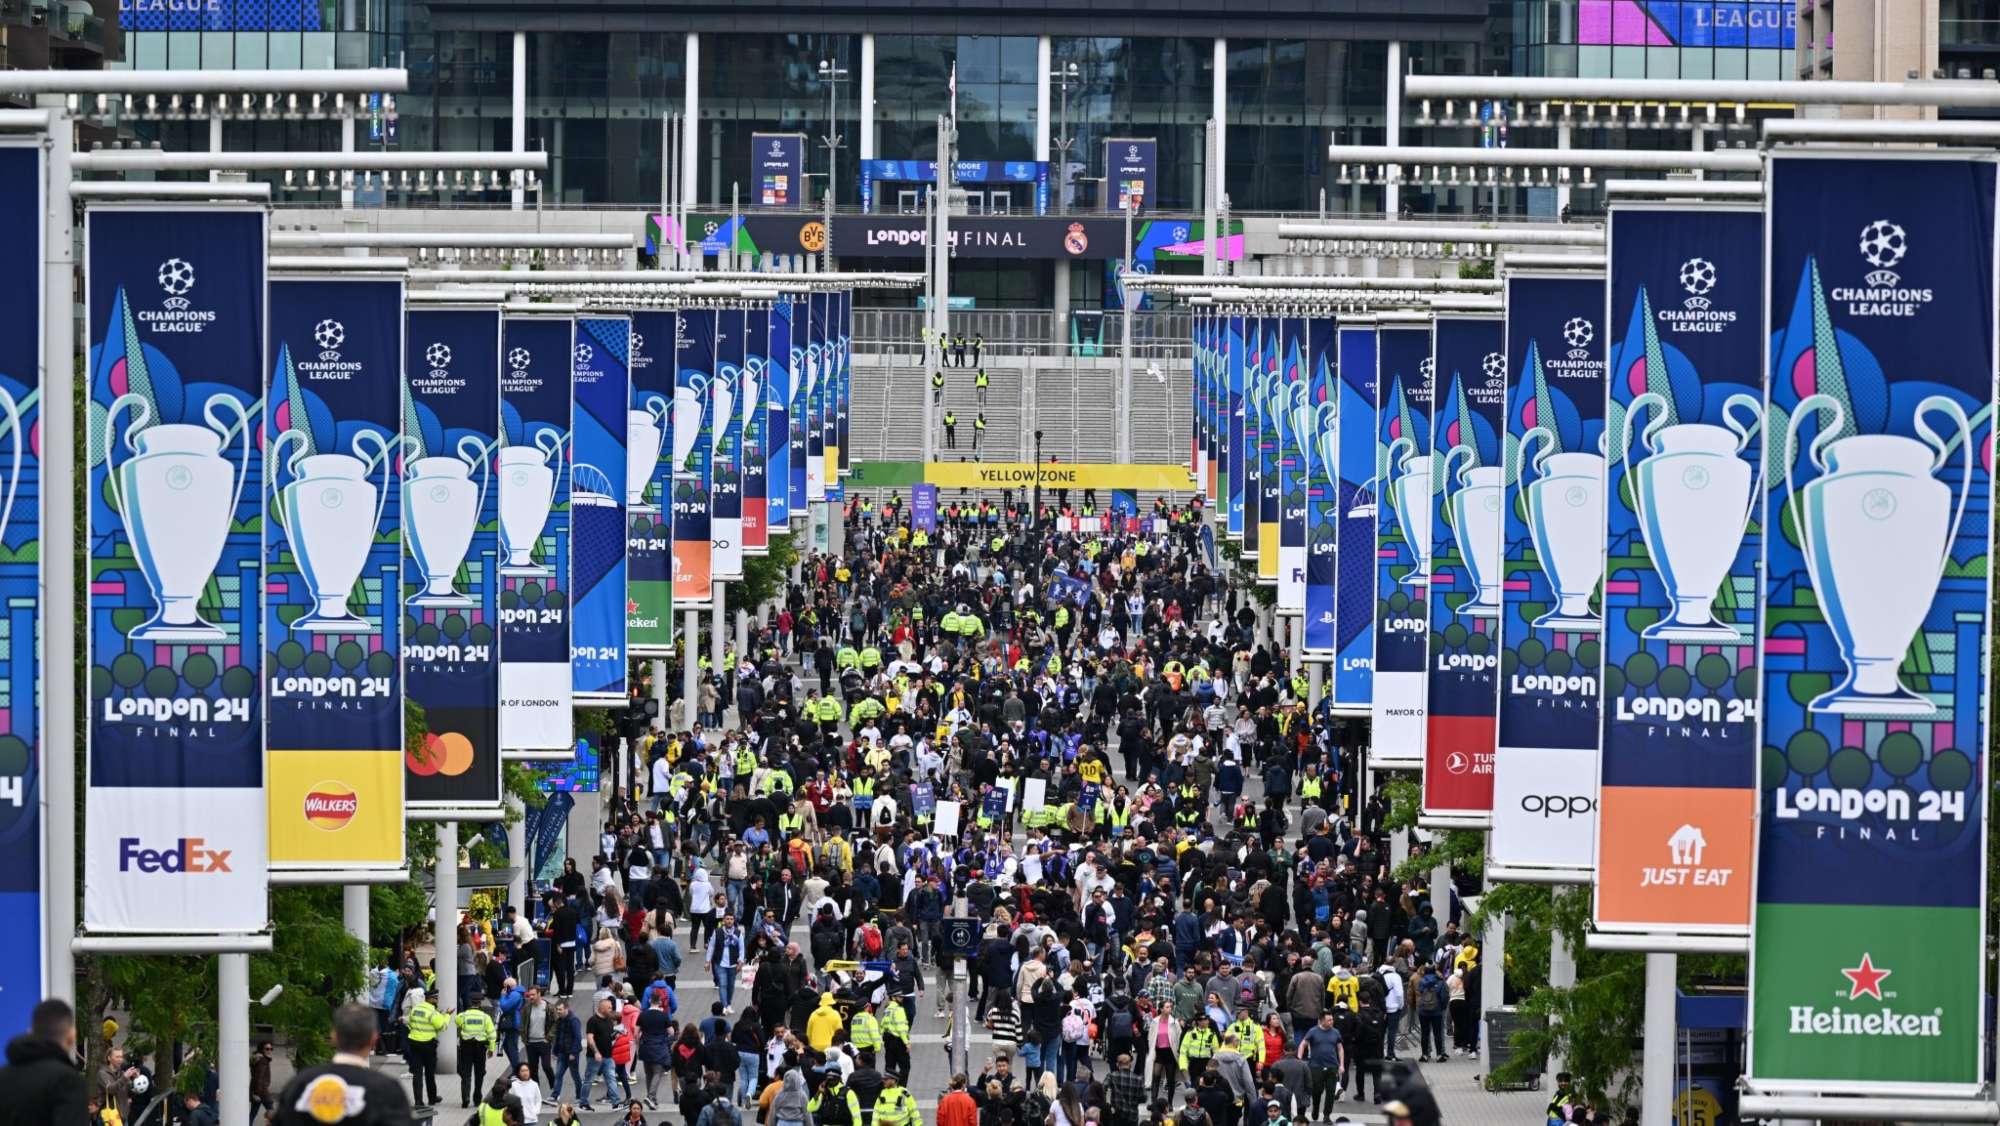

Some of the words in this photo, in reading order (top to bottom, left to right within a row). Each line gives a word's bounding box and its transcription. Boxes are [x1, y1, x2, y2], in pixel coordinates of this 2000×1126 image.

[964, 231, 1027, 246] FINAL
[1864, 270, 1901, 287] UEFA
[1831, 288, 1933, 302] CHAMPIONS
[1658, 310, 1736, 321] CHAMPIONS
[1850, 303, 1916, 316] LEAGUE
[138, 311, 216, 321] CHAMPIONS
[152, 322, 203, 332] LEAGUE
[1672, 322, 1723, 332] LEAGUE
[298, 362, 361, 371] CHAMPIONS
[309, 372, 352, 380] LEAGUE
[1557, 369, 1599, 378] LEAGUE
[412, 379, 466, 387] CHAMPIONS
[1467, 388, 1504, 396] CHAMPI
[1477, 396, 1504, 404] LEAG
[749, 466, 762, 475] 24
[980, 470, 1036, 481] YELLOW
[1040, 470, 1076, 482] ZONE
[722, 484, 736, 494] 24
[690, 503, 705, 513] 24
[649, 539, 666, 550] 24
[676, 574, 693, 582] EAT
[540, 609, 562, 623] 24
[403, 645, 460, 662] onDon
[464, 645, 489, 661] 24
[599, 647, 618, 660] 24
[1438, 654, 1497, 671] LonDo
[360, 677, 391, 697] 24
[213, 698, 250, 722] 24
[298, 701, 363, 710] FINAL
[1726, 698, 1757, 723] 24
[1385, 709, 1414, 717] MAYOR
[136, 727, 216, 737] FINAL
[1648, 726, 1728, 738] FINAL
[1084, 765, 1097, 776] 10
[0, 776, 22, 806] 4
[306, 797, 357, 812] WALKERS
[1918, 790, 1965, 822] 24
[1817, 826, 1920, 841] FINAL
[119, 837, 233, 874] FedEx
[1640, 867, 1689, 888] JUST
[1693, 868, 1732, 887] EAT
[1339, 984, 1352, 997] 11
[840, 1005, 849, 1020] 5
[1789, 1006, 1942, 1037] Heineken
